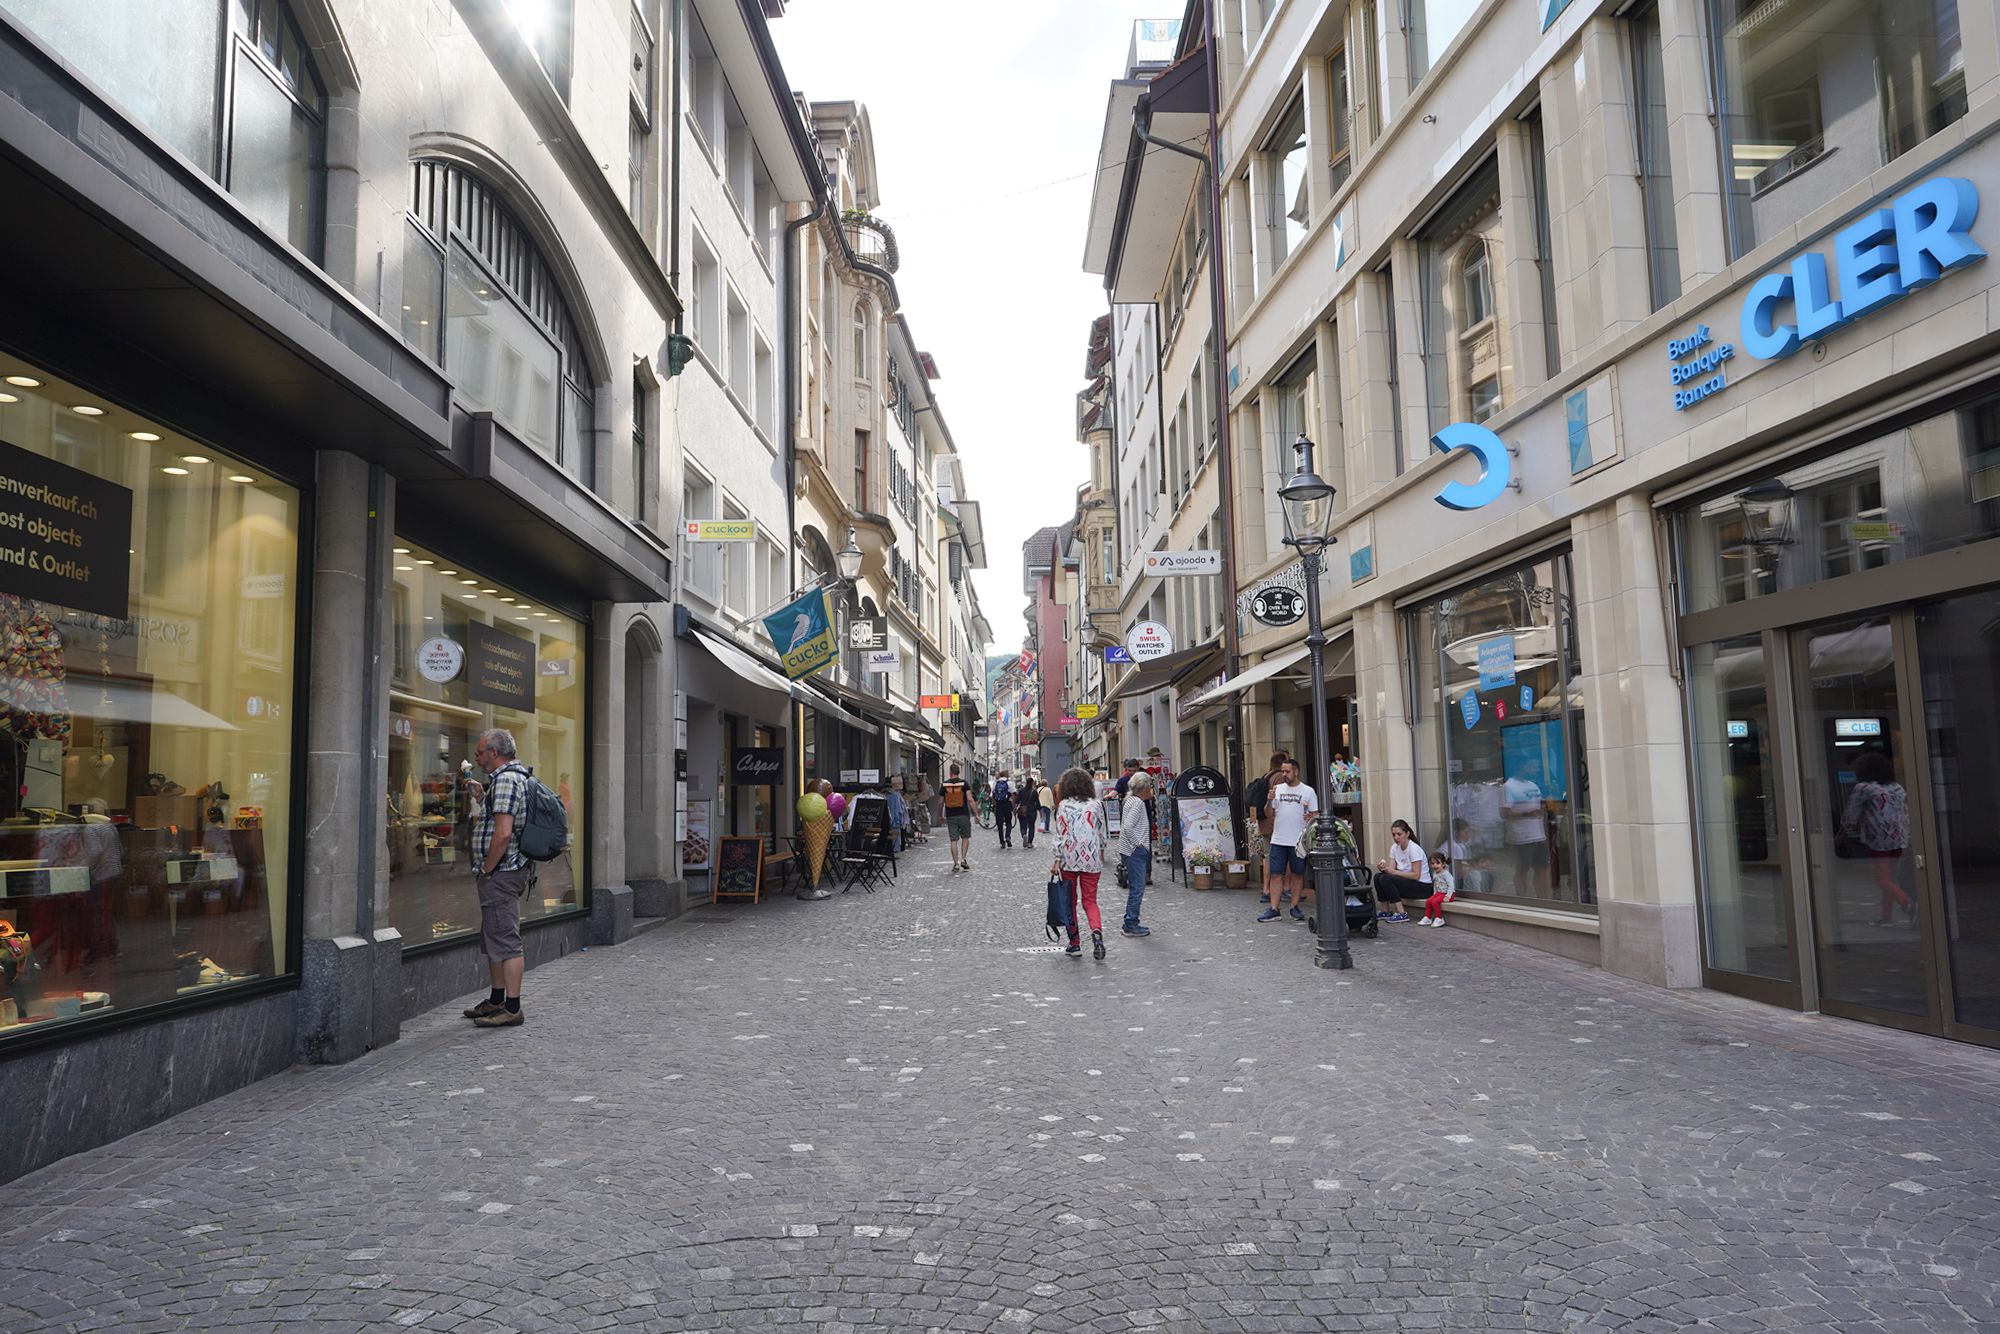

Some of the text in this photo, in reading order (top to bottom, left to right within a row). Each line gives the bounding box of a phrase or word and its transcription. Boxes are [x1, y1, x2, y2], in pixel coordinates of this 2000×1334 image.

[1740, 177, 1988, 359] CLER
[1667, 324, 1713, 360] Bank
[1670, 344, 1735, 386] Banque
[1673, 374, 1726, 411] Banca
[28, 517, 82, 548] objects
[705, 525, 748, 533] cuckoo
[28, 550, 40, 569] &
[43, 554, 91, 582] Outlet
[1175, 556, 1206, 565] ajooda
[1852, 723, 1879, 732] CLER
